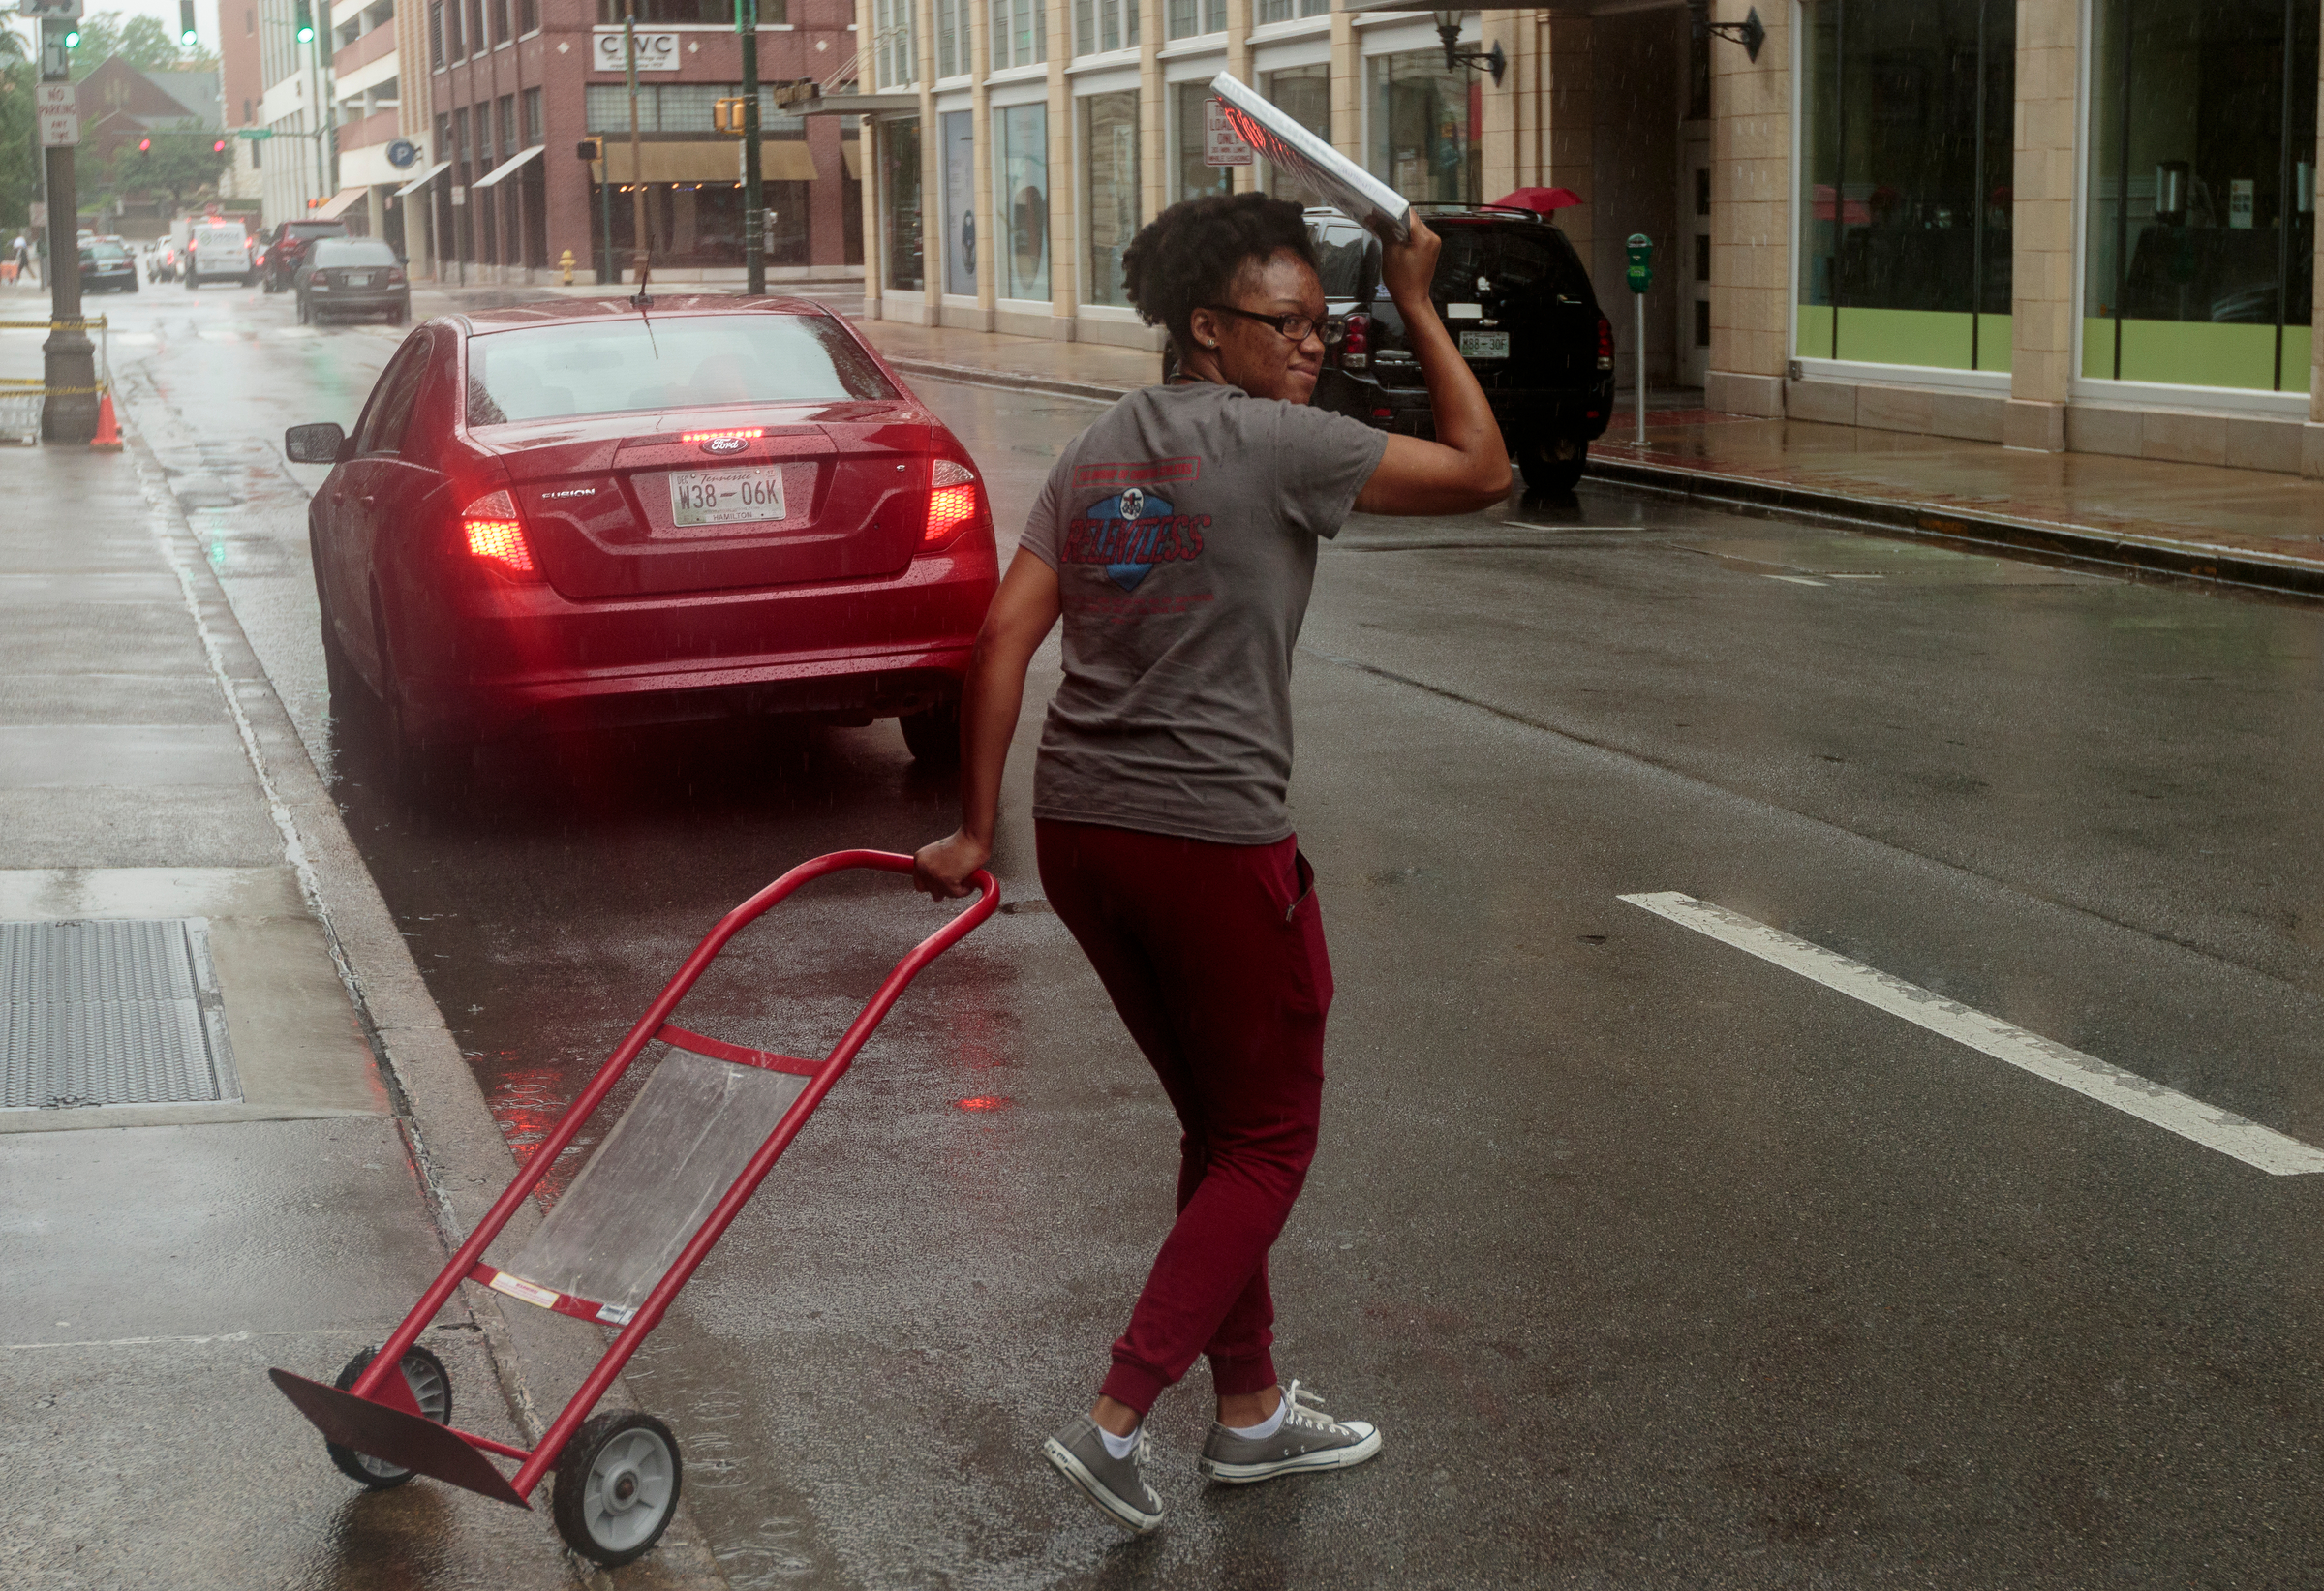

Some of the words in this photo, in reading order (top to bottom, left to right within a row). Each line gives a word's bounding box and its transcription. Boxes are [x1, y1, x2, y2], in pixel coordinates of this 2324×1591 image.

[48, 87, 65, 102] NO
[39, 103, 77, 115] PARKING
[397, 147, 409, 163] P
[711, 438, 740, 450] Ford
[677, 475, 689, 484] DEC
[700, 473, 752, 484] Tennessee
[541, 488, 596, 500] FUSION
[713, 512, 753, 521] HAMILTON
[1061, 514, 1211, 565] RELENTLESS
